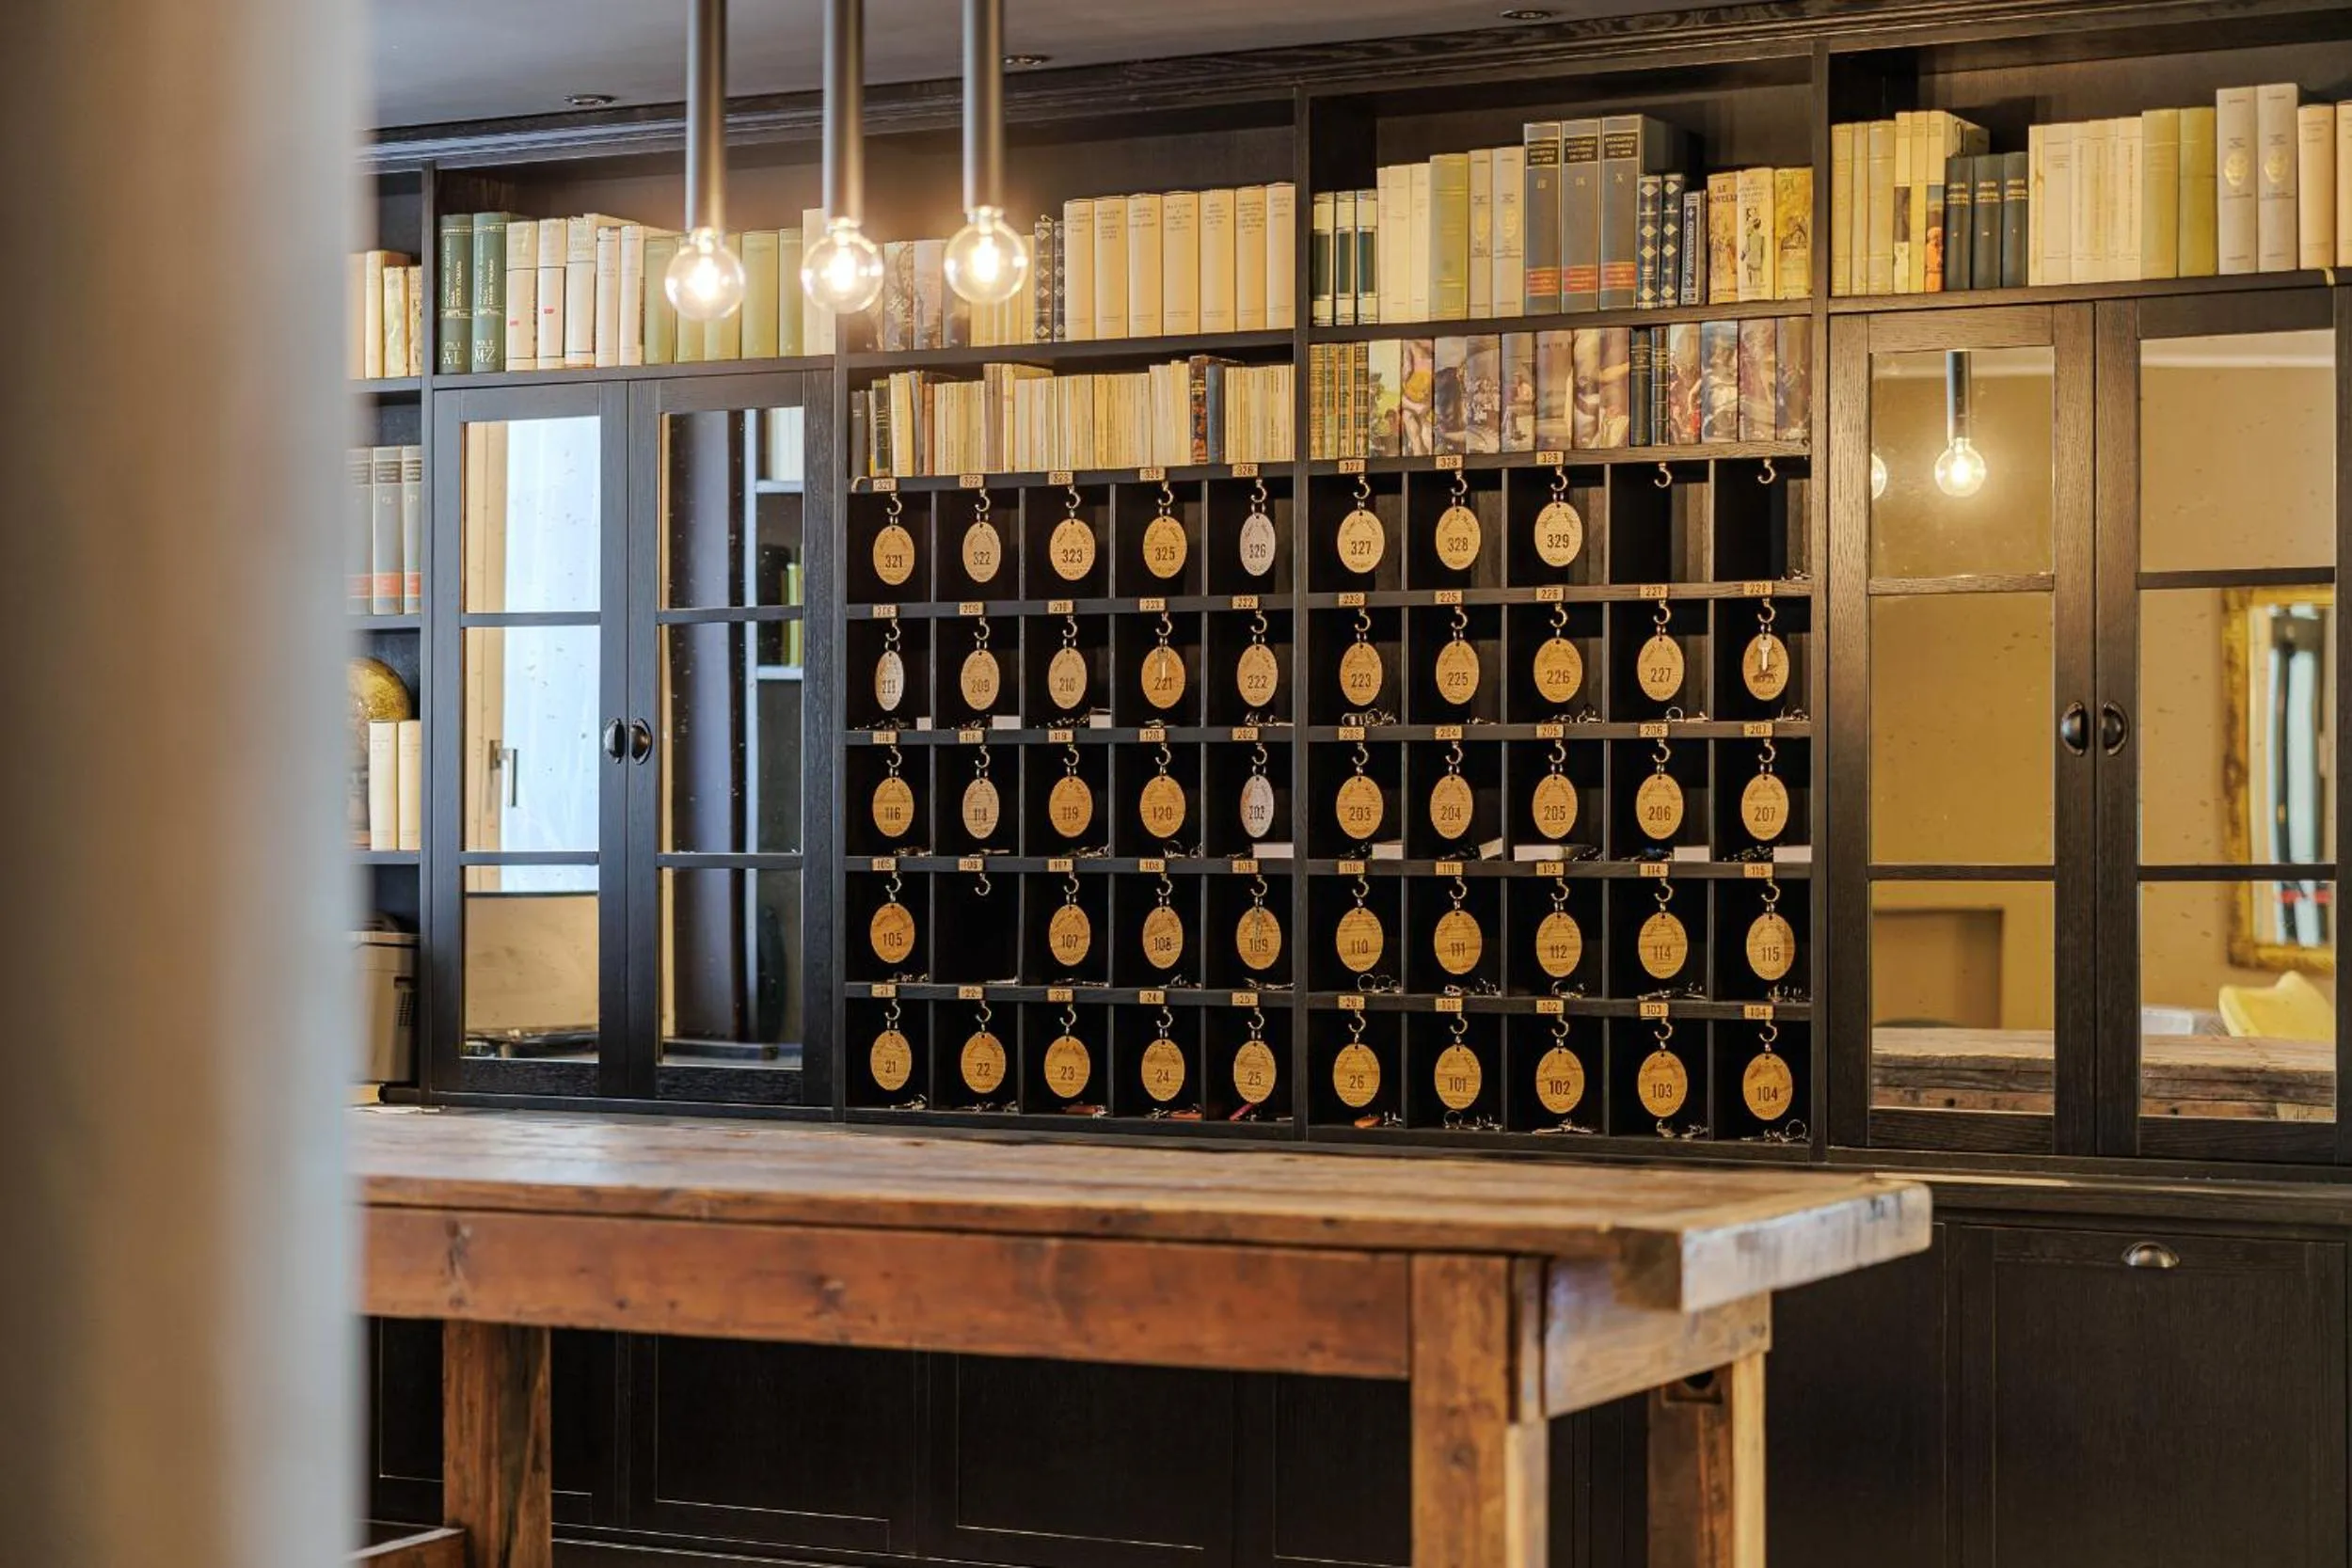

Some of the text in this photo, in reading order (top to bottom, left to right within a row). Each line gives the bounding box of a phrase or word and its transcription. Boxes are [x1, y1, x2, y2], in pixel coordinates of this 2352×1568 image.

[1350, 541, 1372, 556] 327
[1447, 537, 1469, 553] 328
[1547, 534, 1569, 549] 329
[884, 555, 903, 568] 321
[973, 552, 991, 565] 322
[1061, 548, 1083, 564] 323
[1154, 546, 1176, 562] 325
[1248, 675, 1268, 689] 222
[1350, 673, 1372, 689] 223
[1447, 673, 1469, 687] 225
[1546, 670, 1570, 685] 226
[1650, 668, 1672, 683] 227
[1154, 677, 1172, 691] 221
[885, 807, 901, 821] 116
[1152, 807, 1172, 821] 120
[1348, 807, 1372, 821] 203
[1440, 806, 1461, 821] 204
[1543, 806, 1566, 821] 205
[1648, 806, 1671, 821] 206
[1754, 807, 1776, 822] 207
[883, 933, 903, 947] 105
[1061, 934, 1079, 949] 107
[1154, 938, 1172, 952] 108
[1351, 941, 1369, 955] 110
[1449, 942, 1467, 957] 111
[1549, 945, 1567, 959] 112
[1652, 945, 1671, 960] 114
[1762, 947, 1781, 962] 115
[1646, 1005, 1661, 1015] 103
[884, 1060, 897, 1074] 21
[976, 1063, 991, 1077] 22
[1060, 1066, 1075, 1081] 23
[1155, 1069, 1169, 1084] 24
[1248, 1071, 1262, 1086] 25
[1349, 1075, 1365, 1089] 26
[1449, 1077, 1467, 1092] 101
[1549, 1081, 1571, 1096] 102
[1652, 1084, 1673, 1099] 103
[1757, 1086, 1778, 1102] 104
